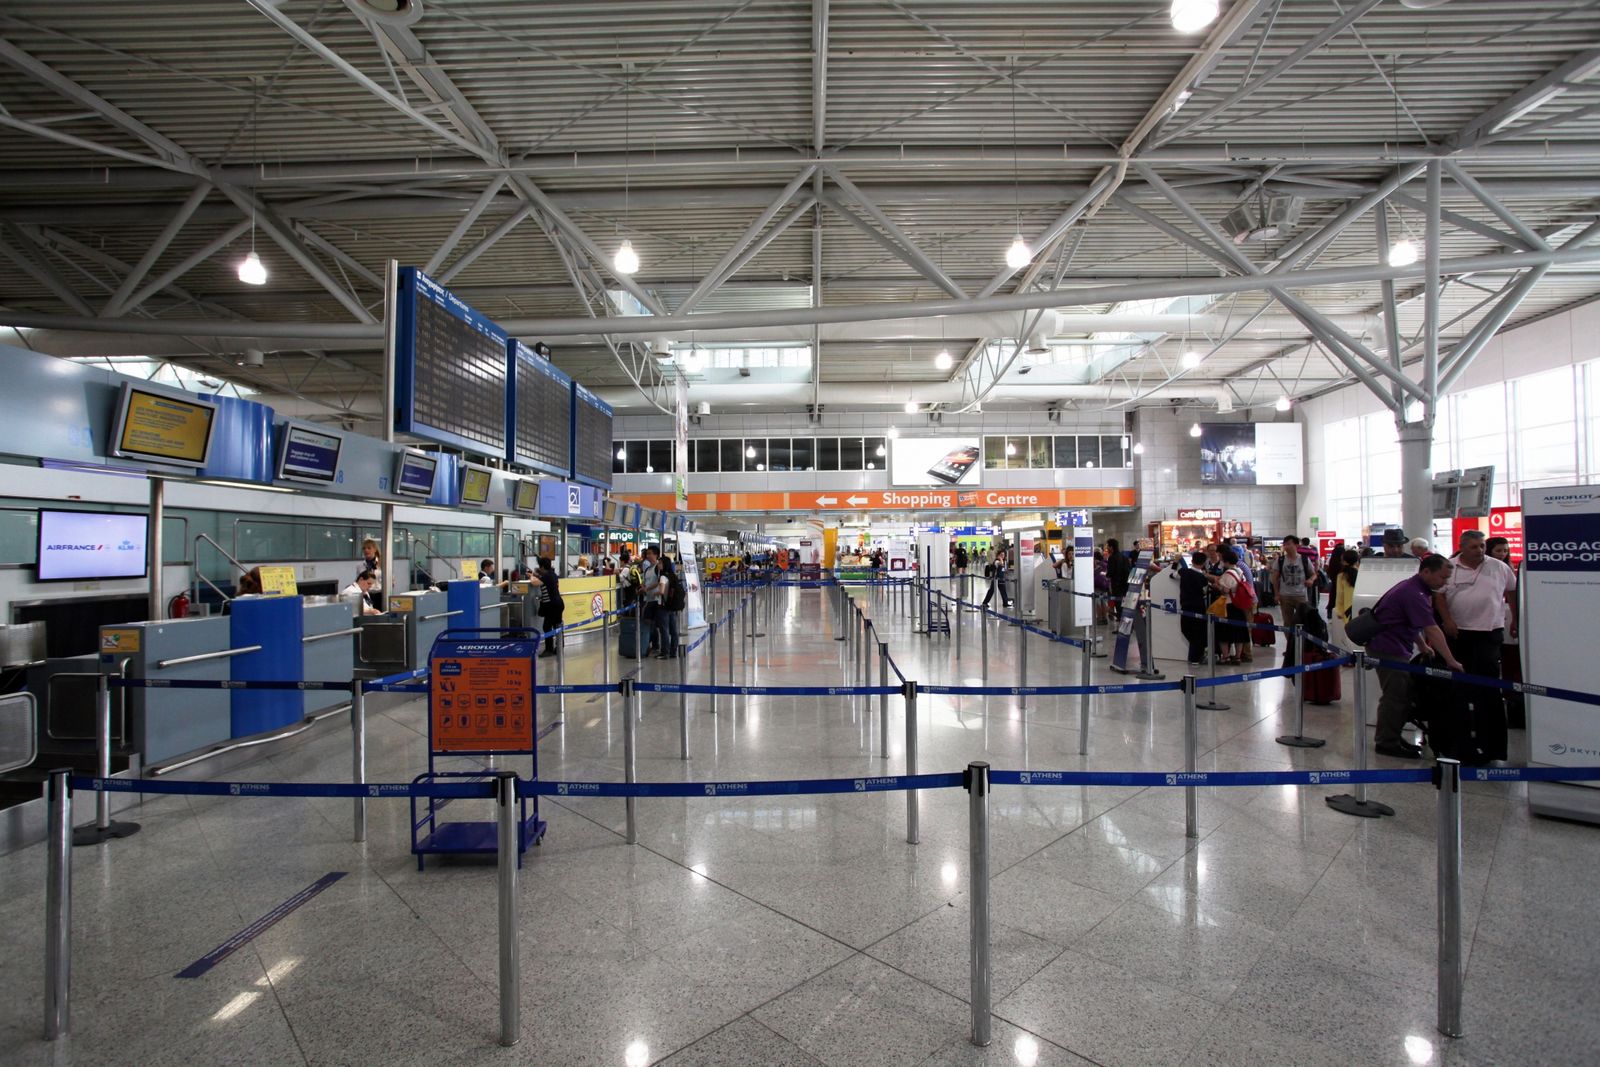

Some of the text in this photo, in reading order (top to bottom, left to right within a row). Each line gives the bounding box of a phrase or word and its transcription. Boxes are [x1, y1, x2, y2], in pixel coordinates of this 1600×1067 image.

[882, 492, 951, 507] Shopping
[986, 492, 1038, 505] Centre
[598, 531, 633, 541] cange
[1570, 747, 1600, 757] SKYT
[103, 779, 133, 787] ATHENS
[865, 777, 898, 785] ATHENS
